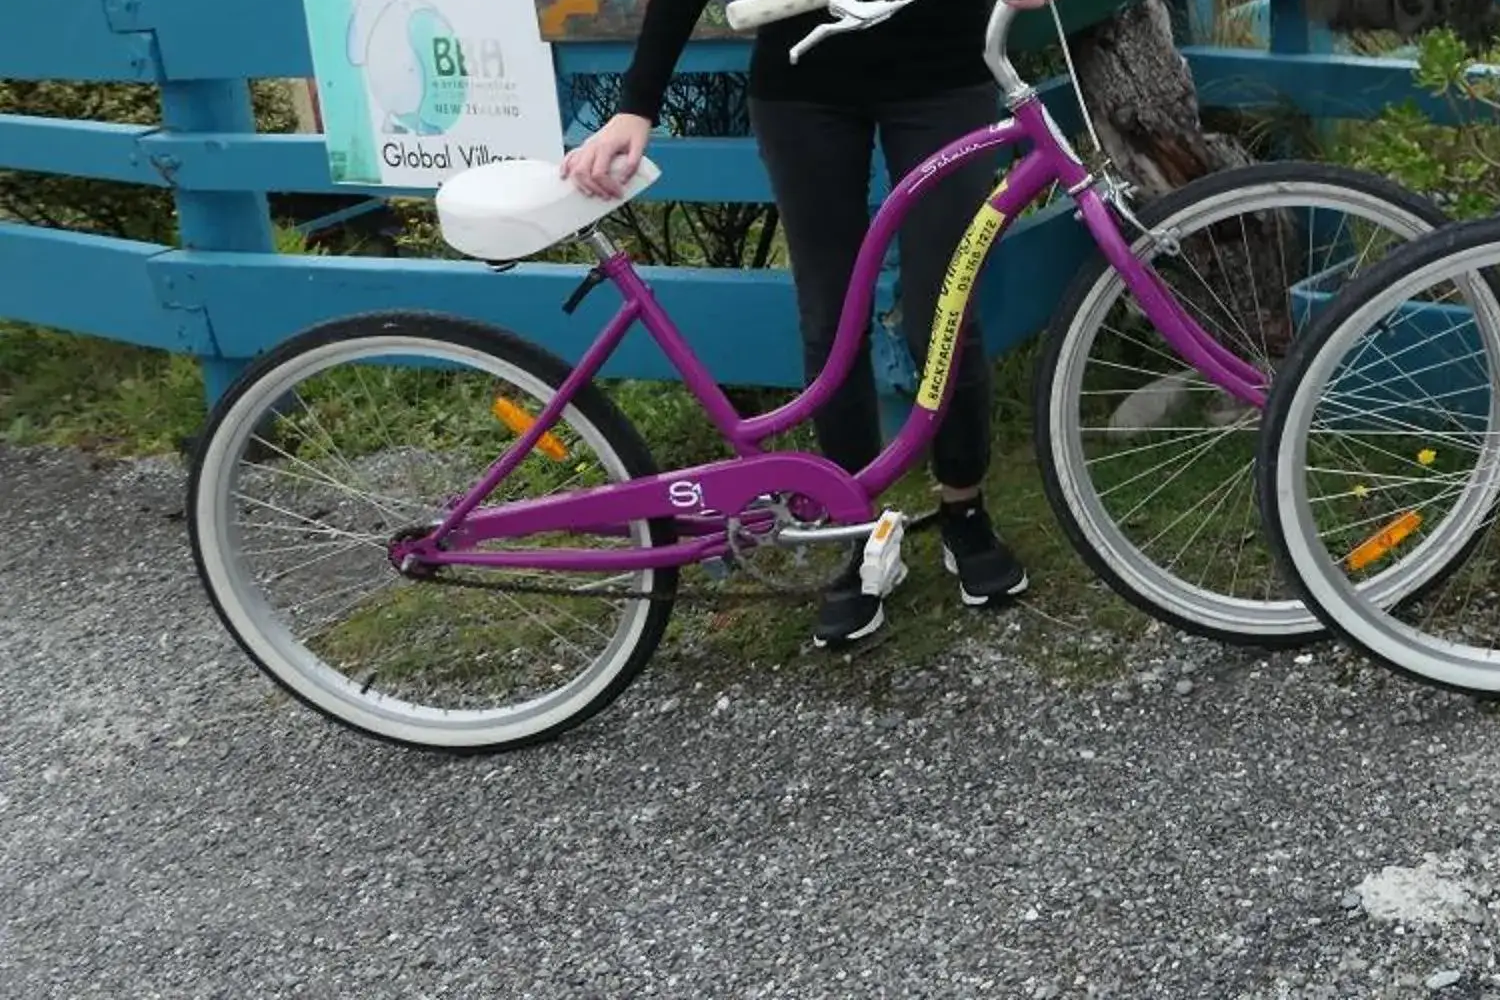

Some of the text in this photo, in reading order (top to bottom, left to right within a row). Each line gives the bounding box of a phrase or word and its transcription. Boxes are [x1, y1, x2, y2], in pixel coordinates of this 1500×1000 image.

[432, 37, 505, 77] BBH
[383, 143, 527, 169] Global Vill
[928, 310, 960, 401] BACKPACKERS
